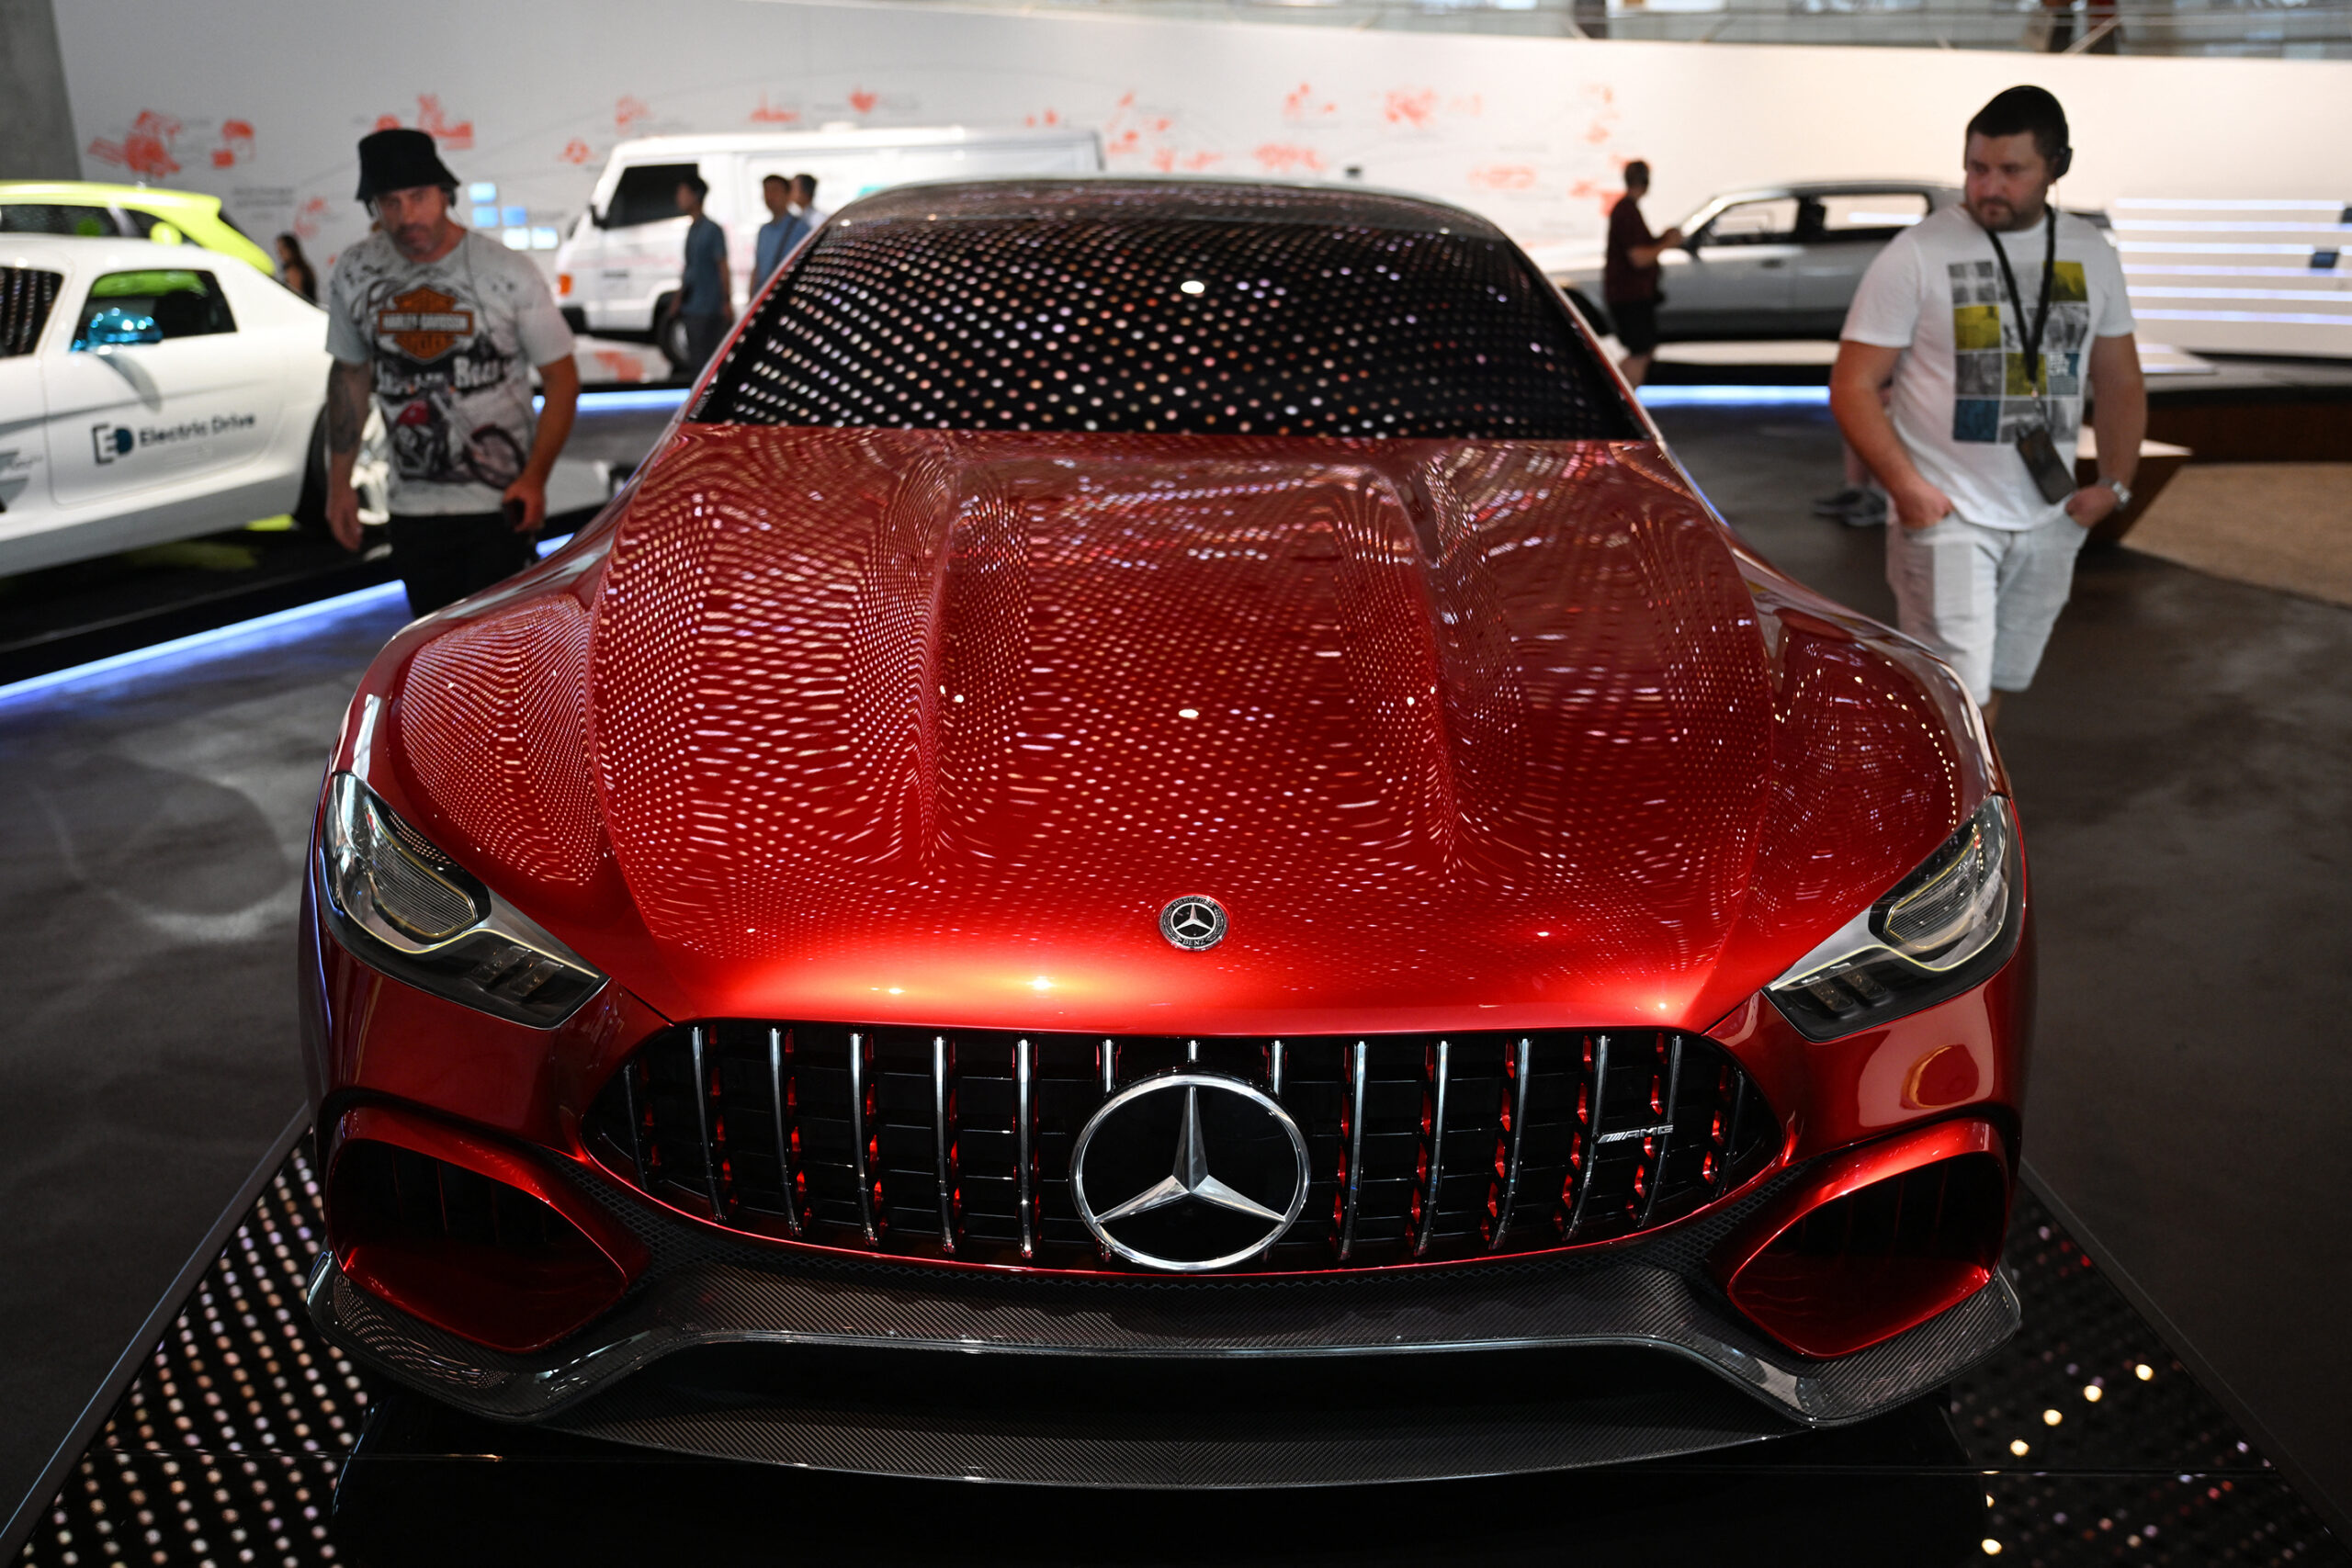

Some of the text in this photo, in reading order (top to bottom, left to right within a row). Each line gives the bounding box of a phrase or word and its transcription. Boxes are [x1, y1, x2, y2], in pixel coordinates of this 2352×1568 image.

[140, 423, 208, 447] Electric
[211, 414, 256, 435] Drive
[1622, 1124, 1673, 1141] AMG
